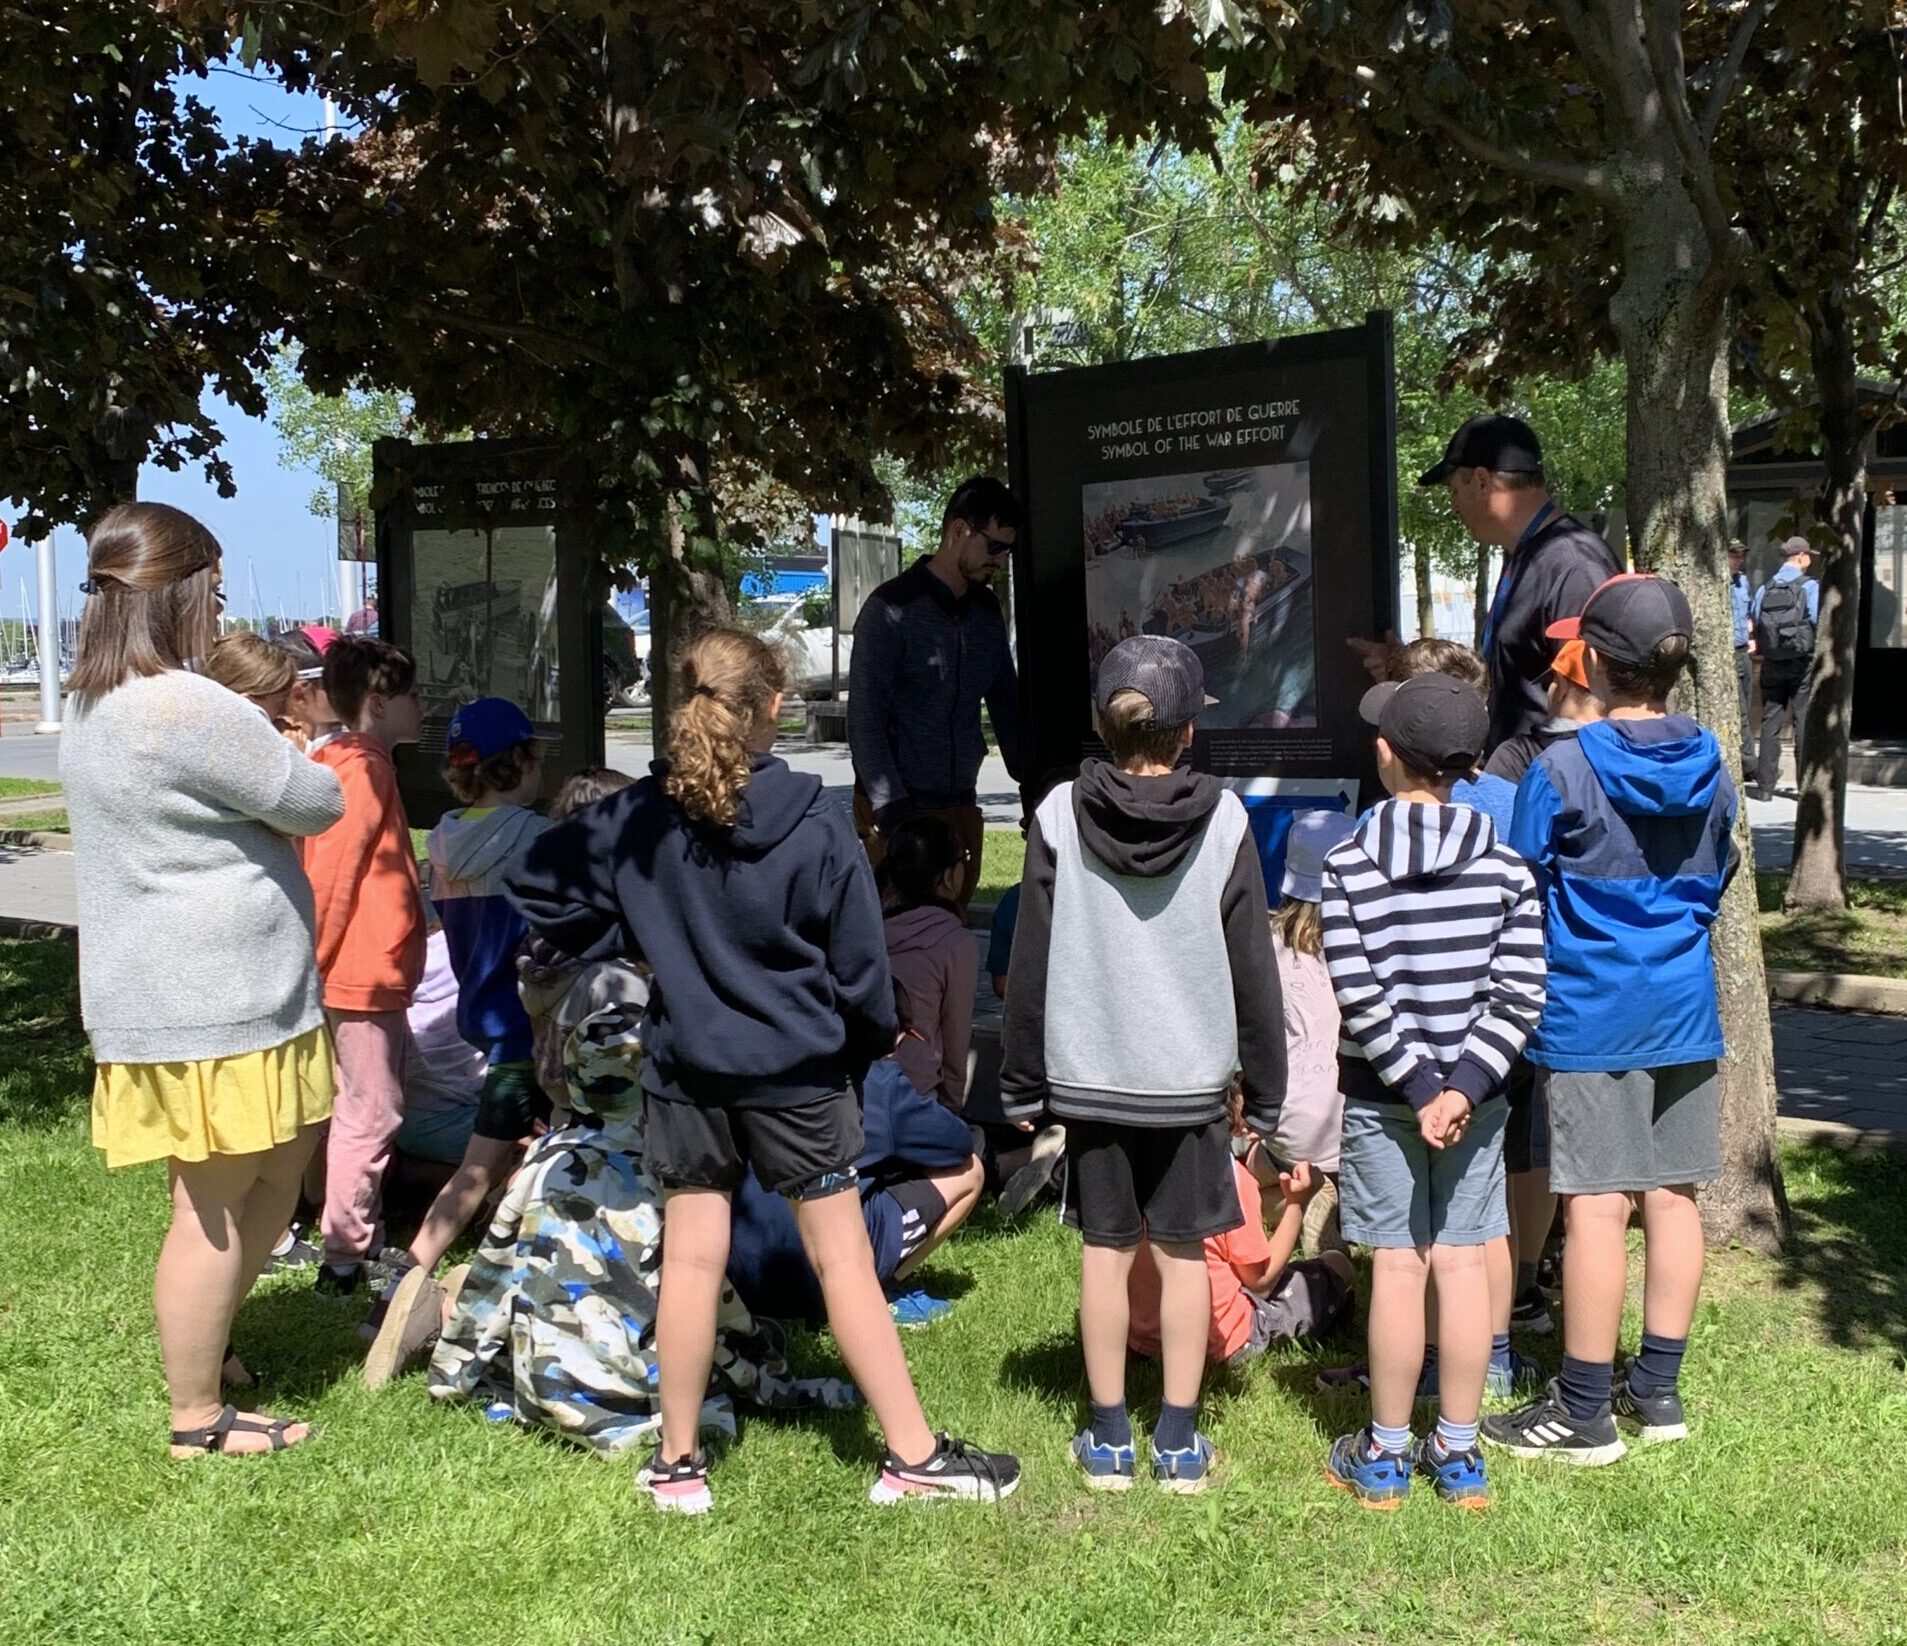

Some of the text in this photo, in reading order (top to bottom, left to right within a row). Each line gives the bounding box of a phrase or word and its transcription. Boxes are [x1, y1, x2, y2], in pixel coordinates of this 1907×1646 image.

[1088, 399, 1300, 439] SYMBOLE DE L'EFFORT DE GUERRE
[1101, 424, 1286, 460] SYMBOL OF THE WAR EFFORT
